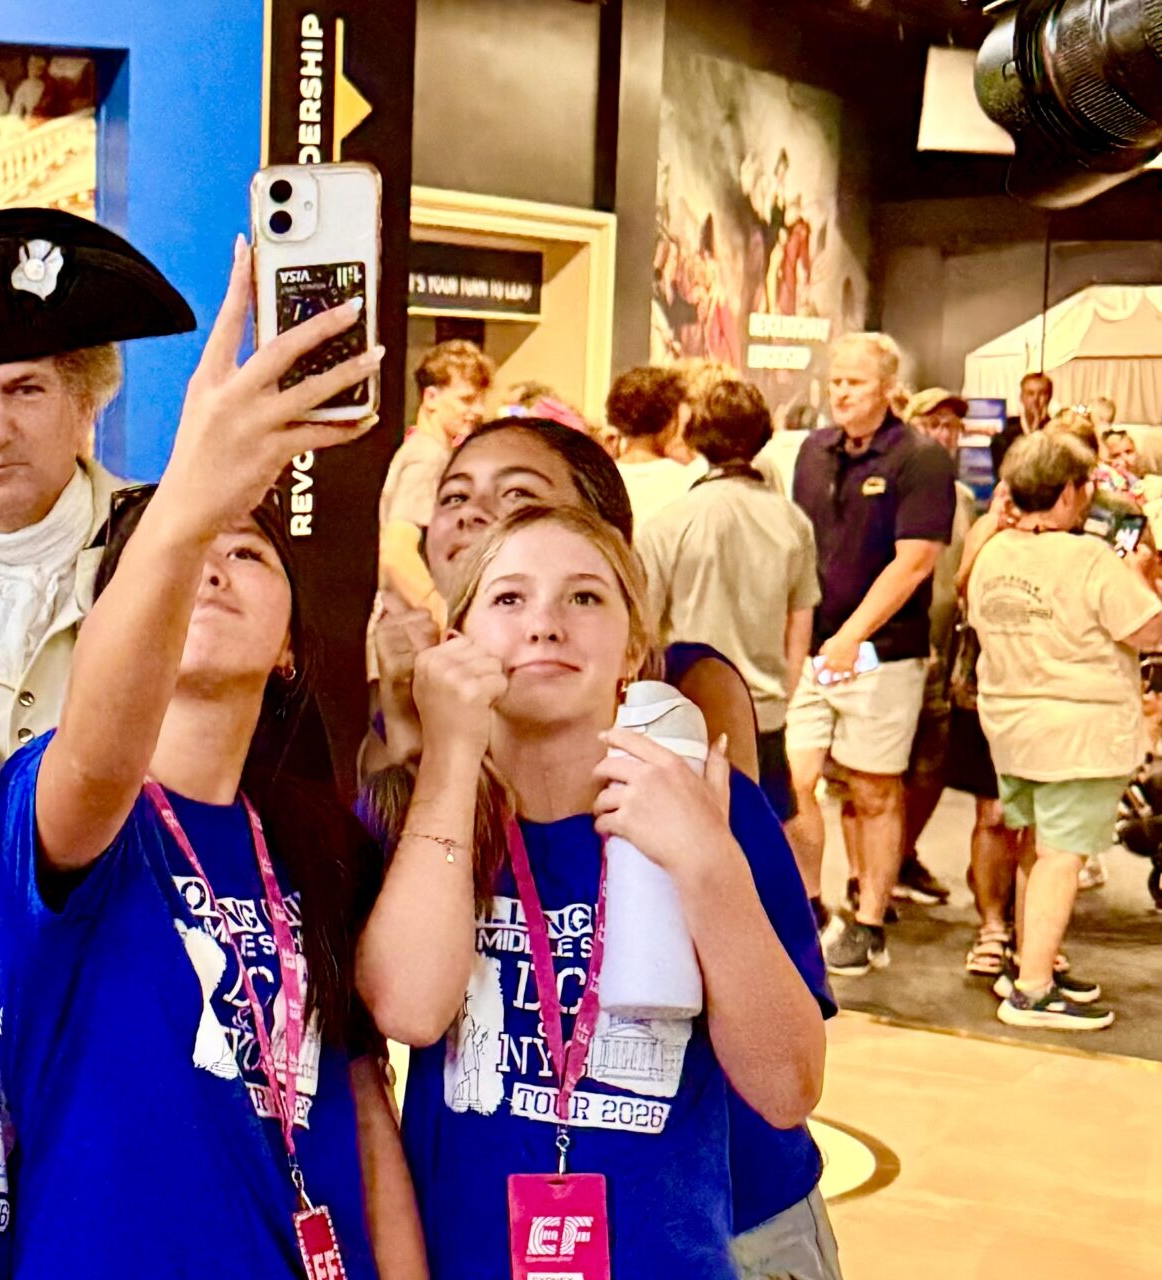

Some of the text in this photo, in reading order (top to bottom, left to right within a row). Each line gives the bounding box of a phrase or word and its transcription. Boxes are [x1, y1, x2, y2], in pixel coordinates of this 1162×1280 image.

[279, 269, 312, 284] VISA
[602, 1100, 665, 1128] 2026
[526, 1216, 594, 1255] EF
